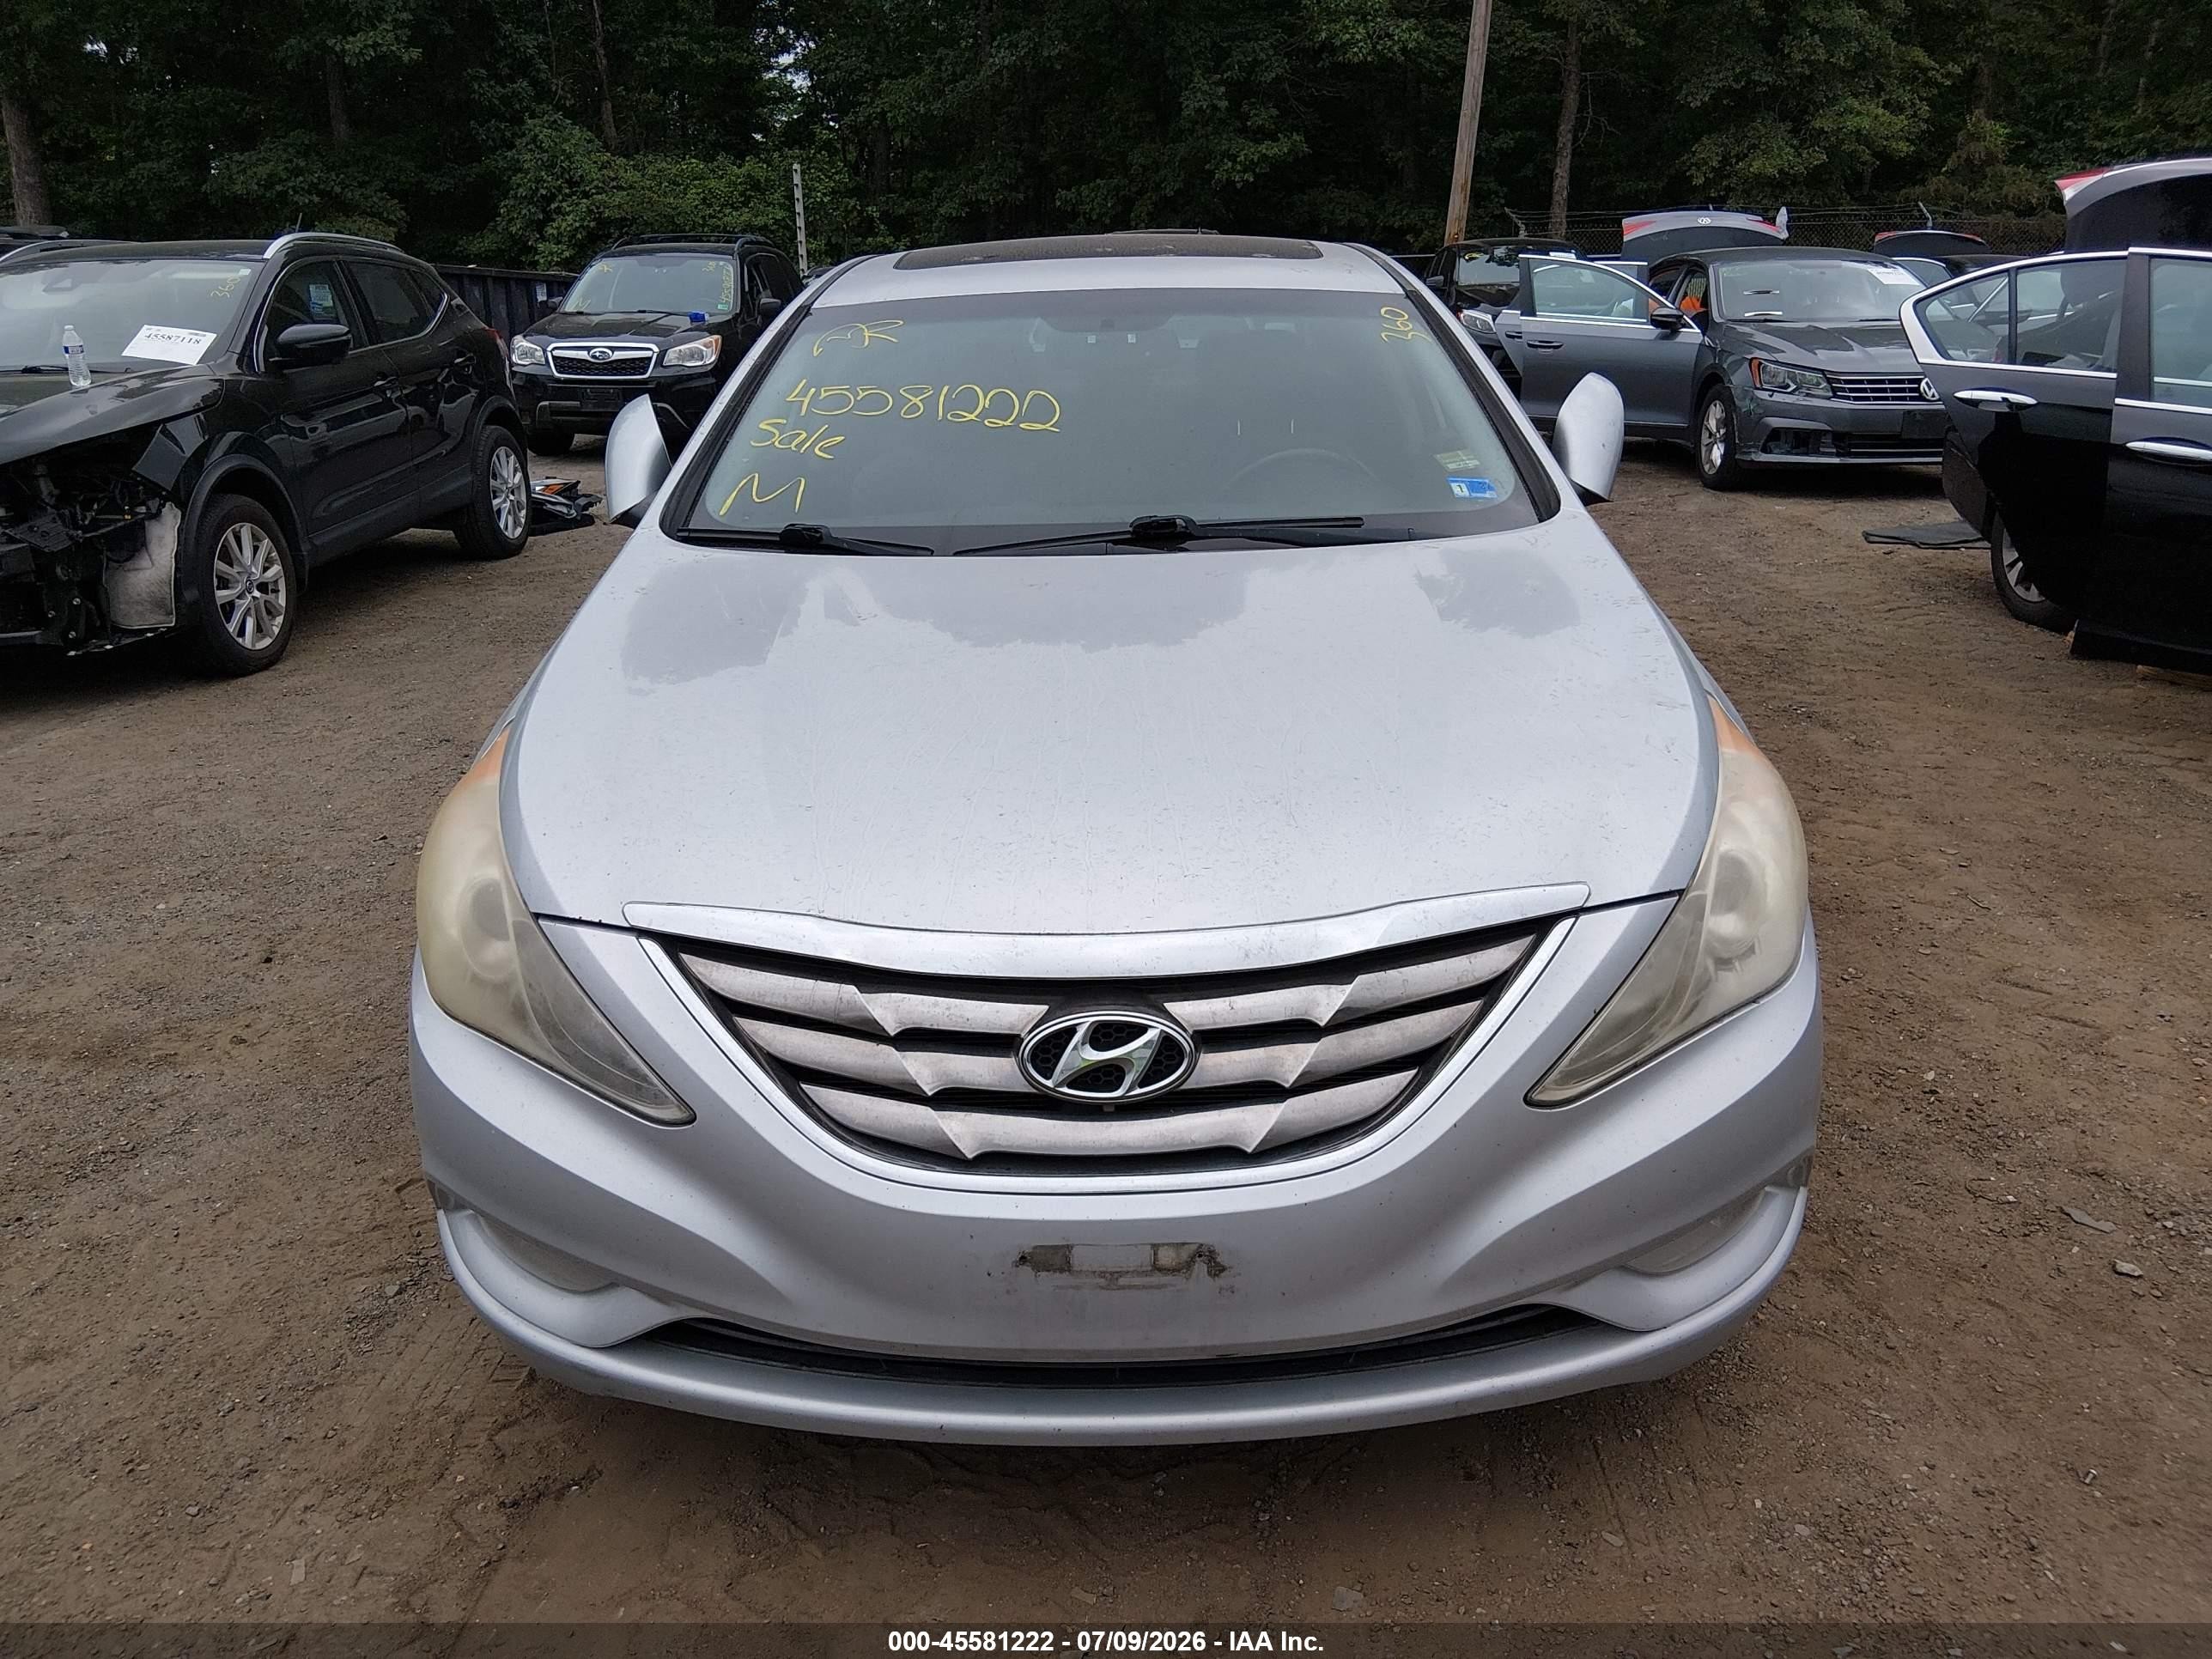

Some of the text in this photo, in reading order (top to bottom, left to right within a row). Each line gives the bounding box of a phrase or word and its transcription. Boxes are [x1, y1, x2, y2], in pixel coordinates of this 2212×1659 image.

[210, 276, 241, 298] 360
[785, 378, 1061, 433] 45581222
[749, 418, 846, 460] Sale
